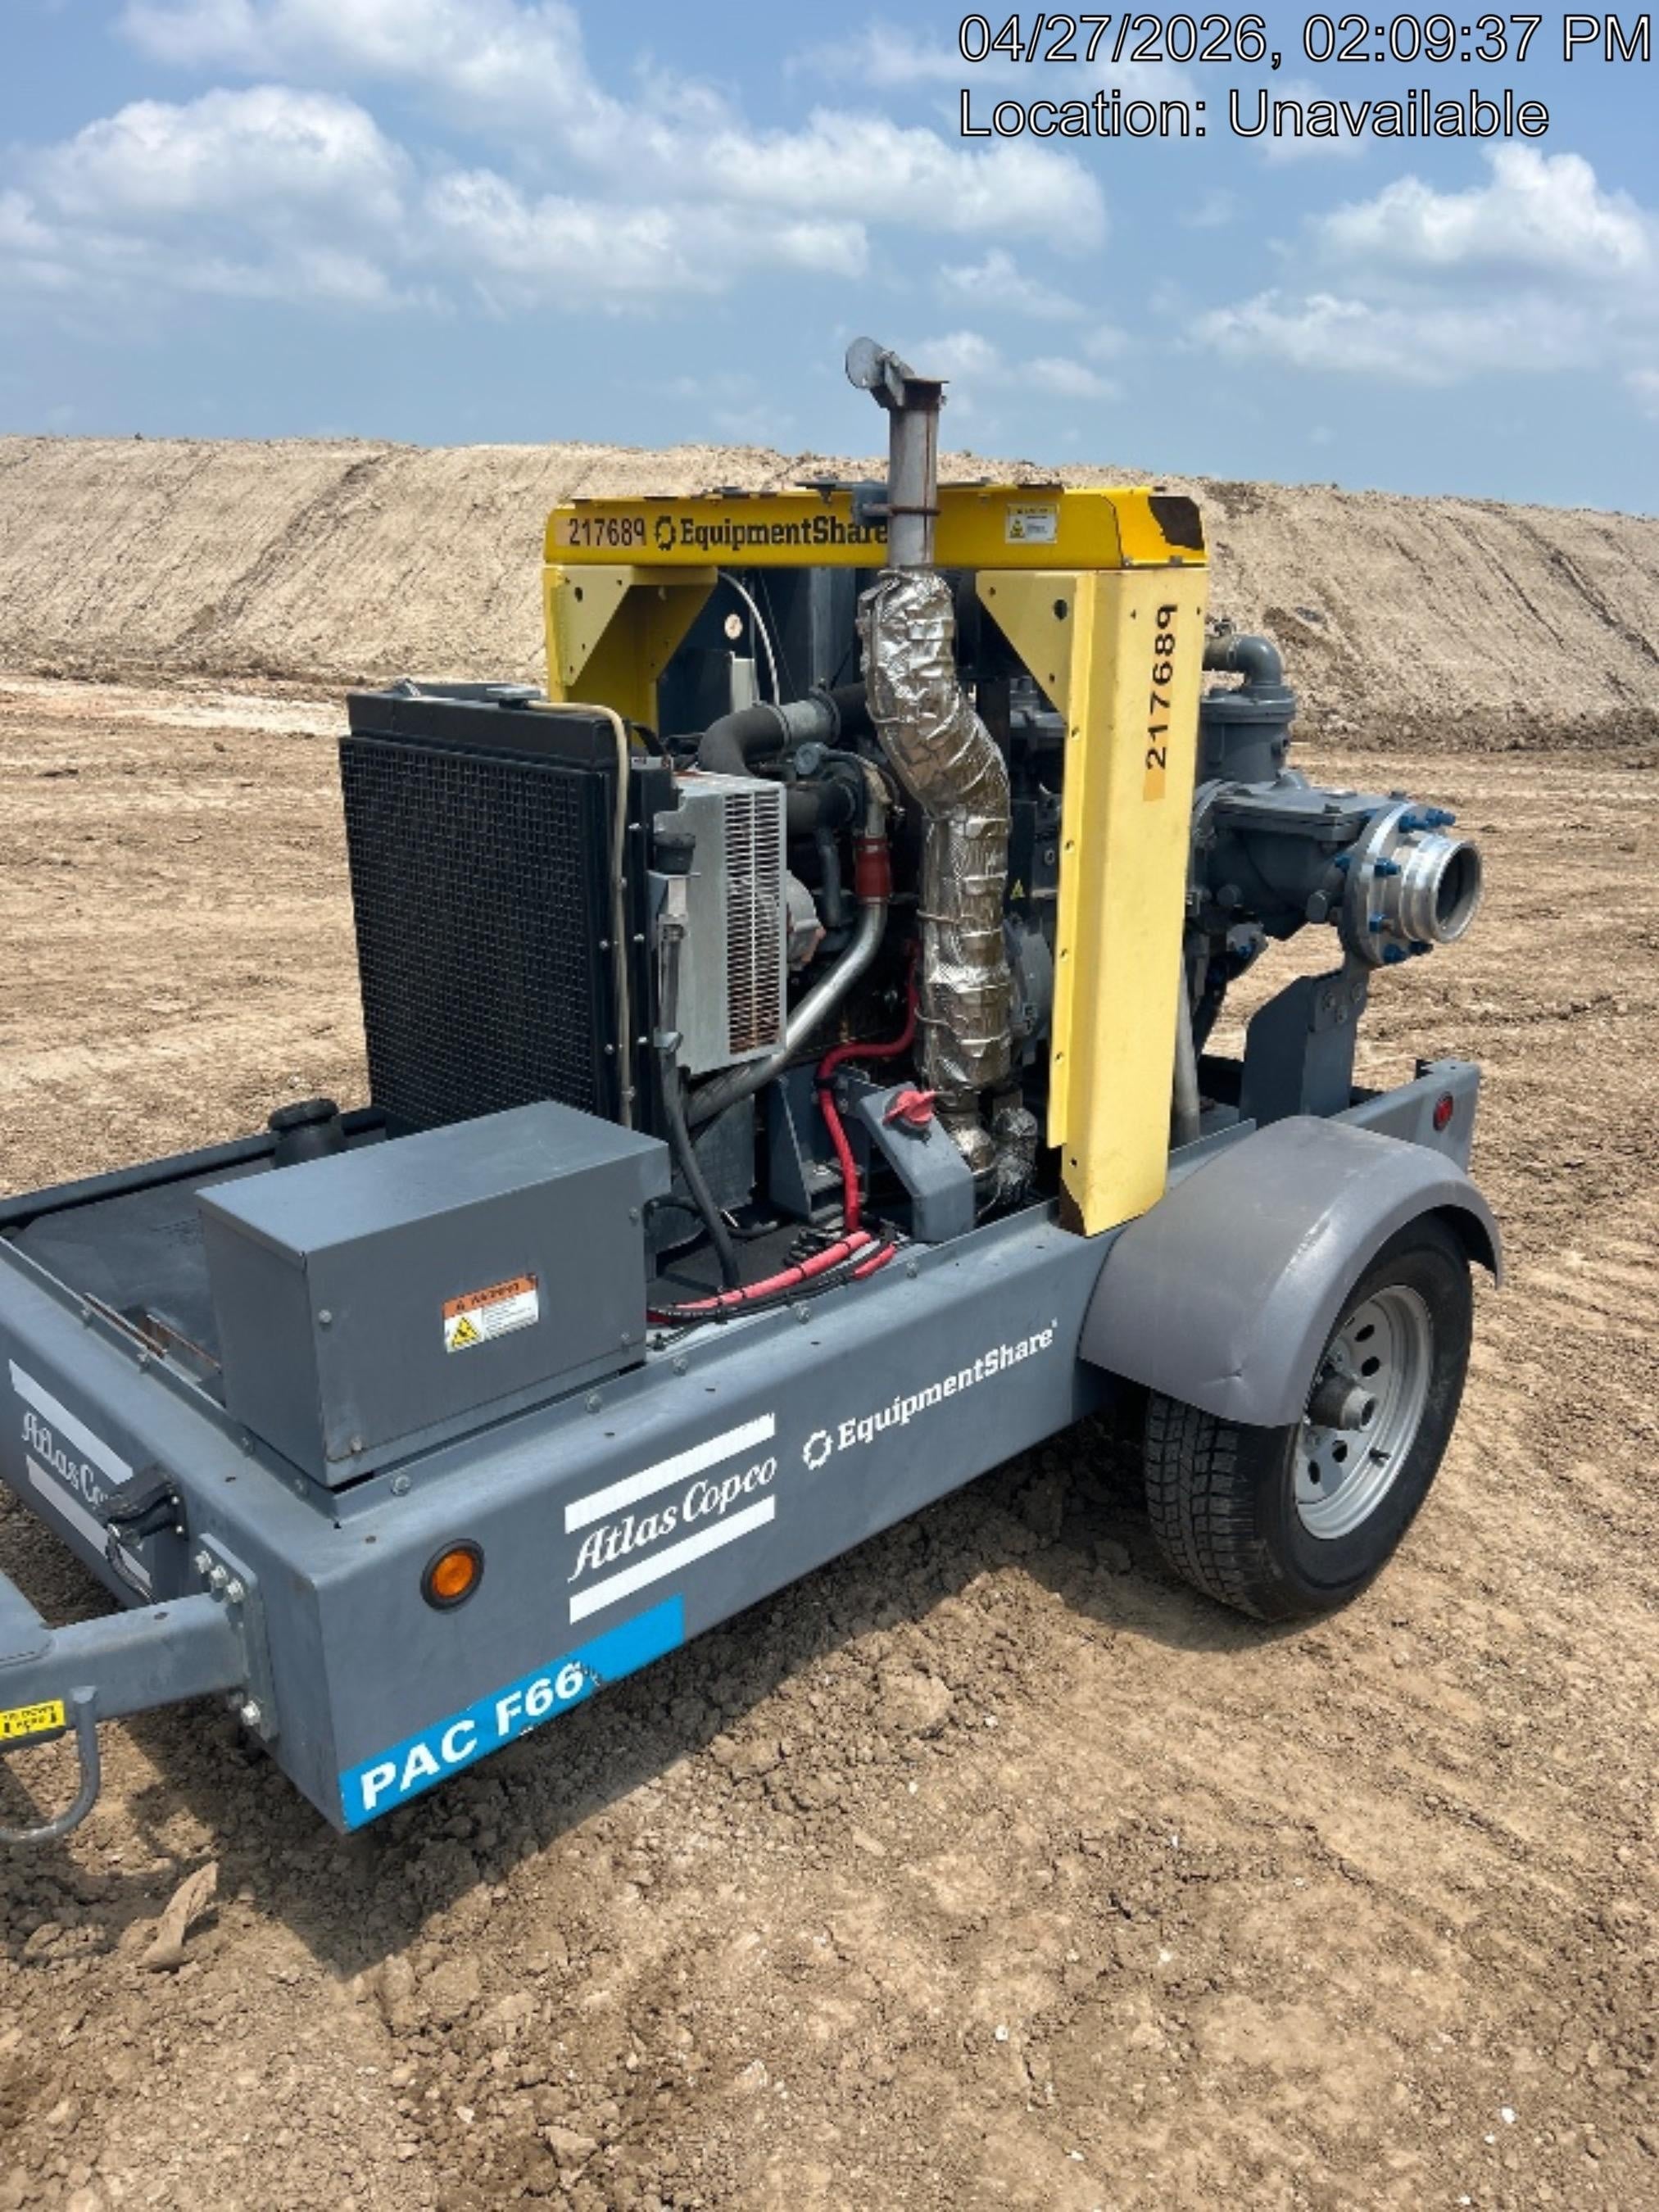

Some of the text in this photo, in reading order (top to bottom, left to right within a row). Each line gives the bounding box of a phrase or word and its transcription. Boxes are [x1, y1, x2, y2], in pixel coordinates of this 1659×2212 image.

[569, 518, 647, 546] 217689
[680, 515, 888, 551] EquipmentShare
[1147, 603, 1179, 770] 217689
[21, 1412, 79, 1490] Atlas
[837, 1329, 1054, 1451] EquipmentShare
[567, 1457, 777, 1584] Atlas Copco
[360, 1662, 584, 1810] PAC F66
